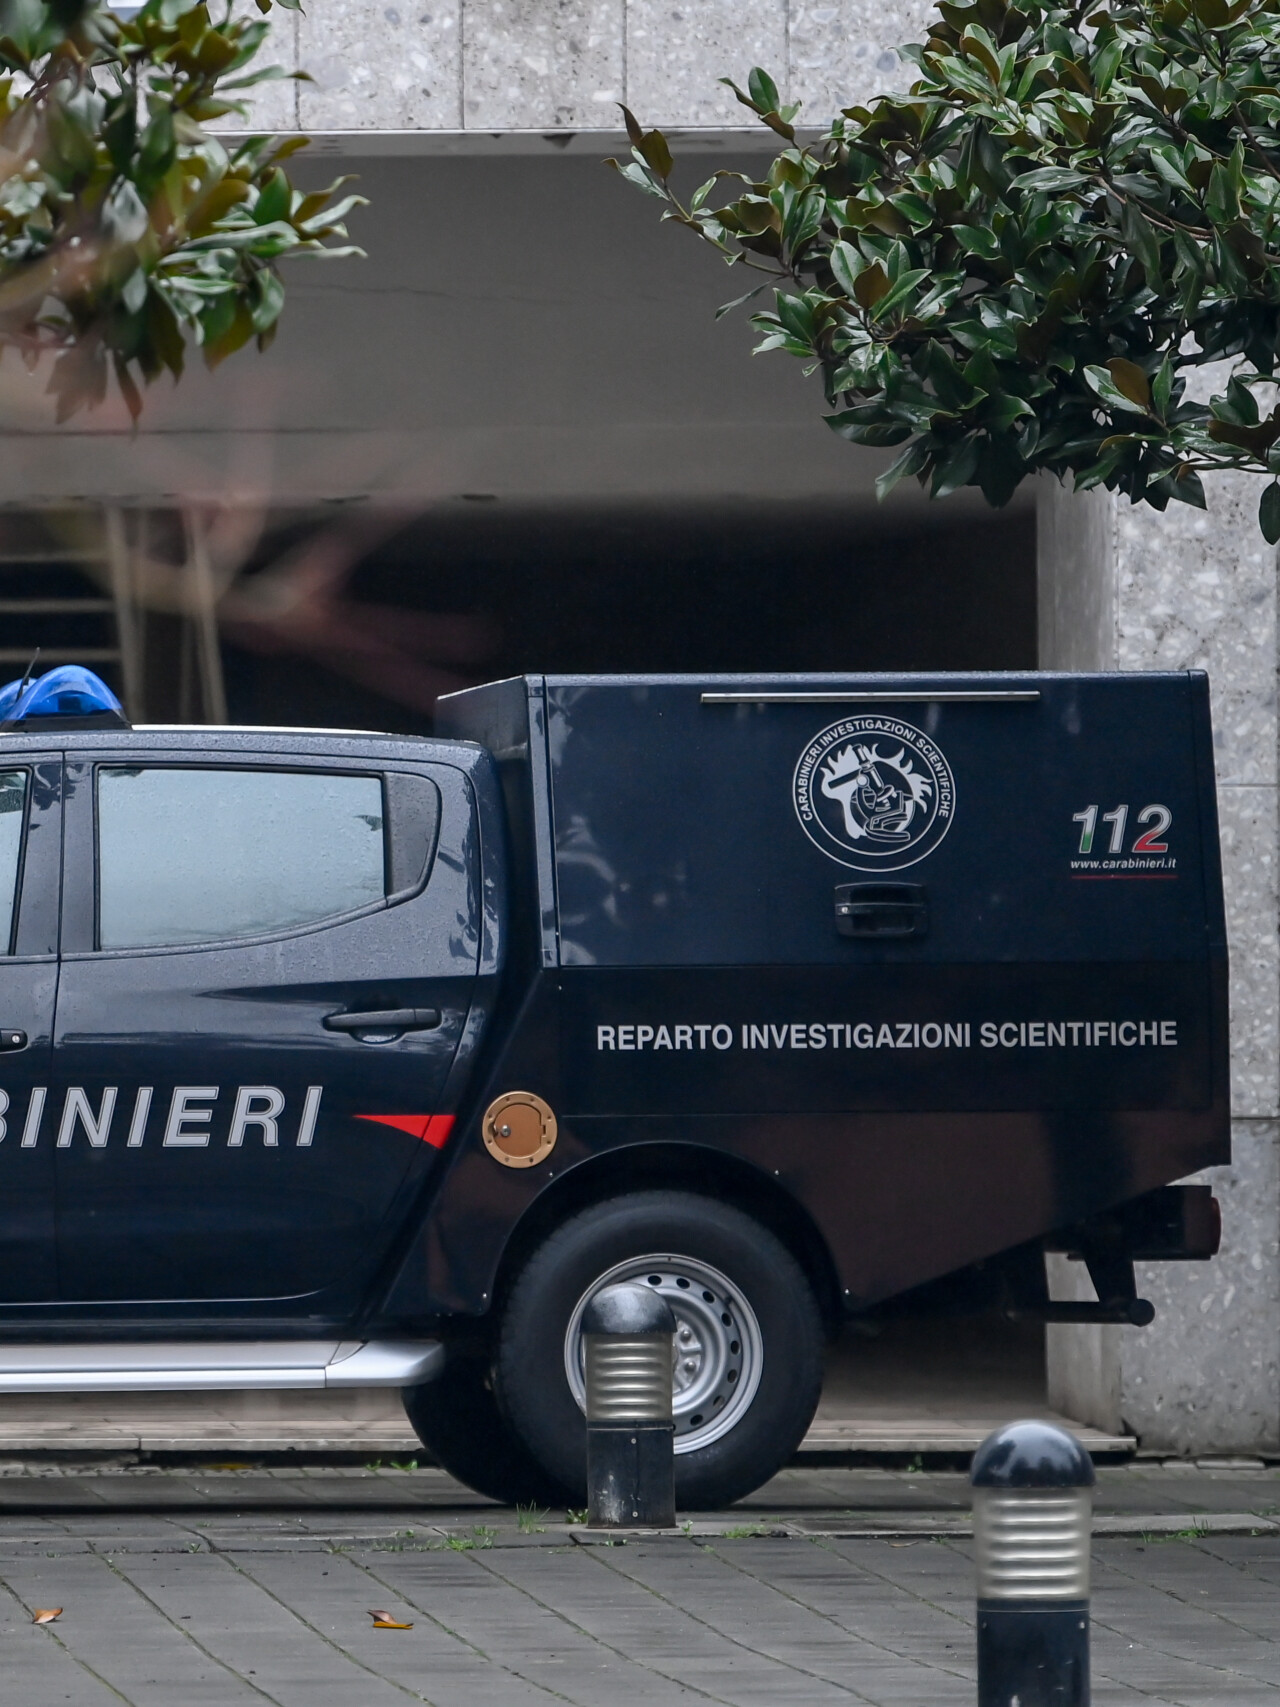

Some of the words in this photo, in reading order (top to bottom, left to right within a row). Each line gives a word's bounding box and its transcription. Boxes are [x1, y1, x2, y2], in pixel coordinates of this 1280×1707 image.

[798, 745, 822, 822] CARABINIERI
[819, 719, 916, 747] INVESTIGAZIONI
[915, 738, 952, 819] SCIENTIFICHE
[1072, 803, 1173, 854] 112
[1071, 857, 1177, 870] www.carabinieri.it
[596, 1025, 733, 1051] REPARTO
[741, 1022, 971, 1050] INVESTIGAZIONI
[979, 1020, 1178, 1049] SCIENTIFICHE
